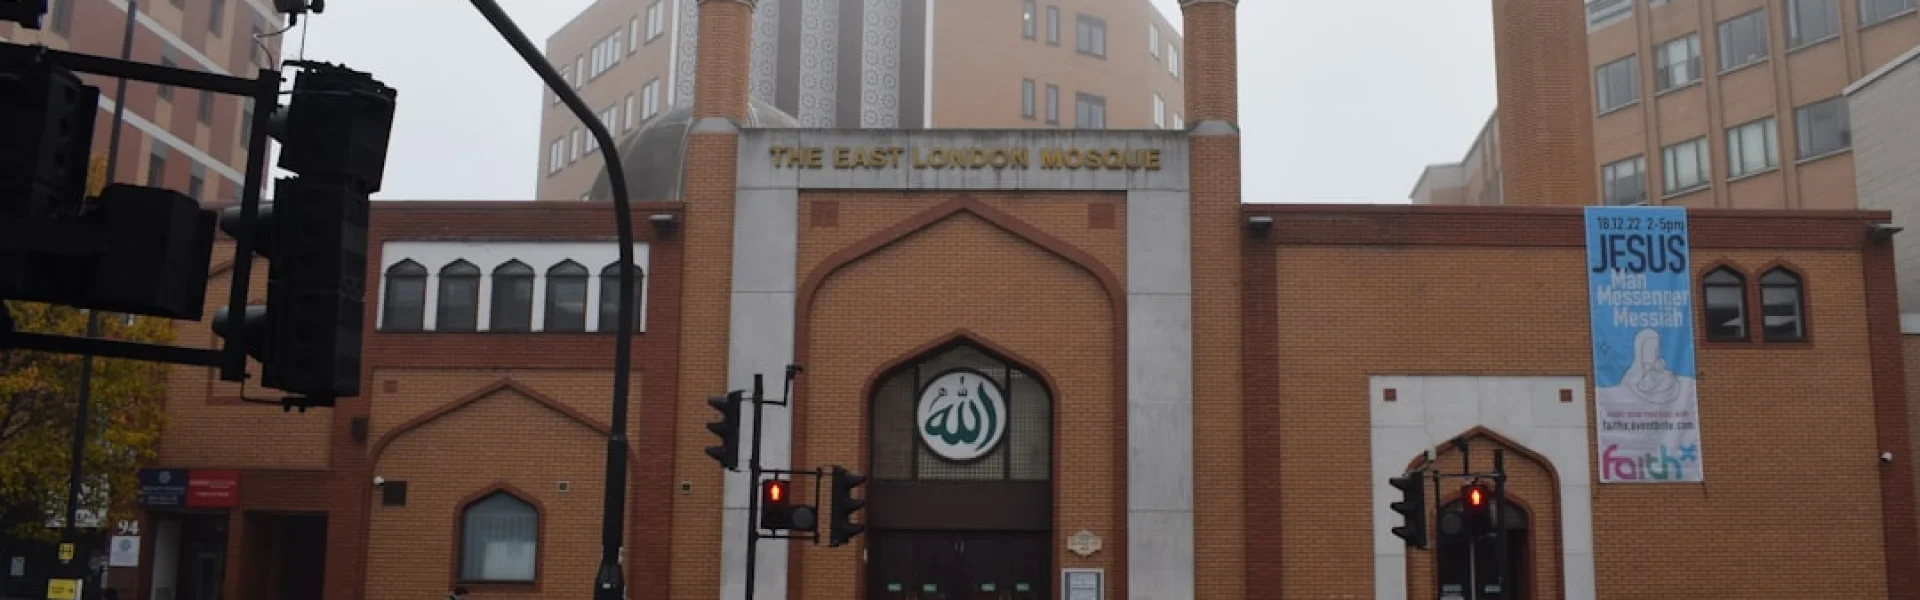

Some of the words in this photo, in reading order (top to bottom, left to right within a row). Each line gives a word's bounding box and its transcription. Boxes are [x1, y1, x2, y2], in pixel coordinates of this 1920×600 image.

[768, 146, 823, 169] THE
[834, 146, 904, 169] EAST
[913, 146, 1029, 169] LONDON
[1041, 146, 1160, 170] MOSQUE
[1597, 216, 1640, 230] 18.12.22
[1593, 234, 1686, 273] JESUS
[1611, 267, 1647, 289] Man
[1597, 284, 1689, 308] Messenger
[1613, 305, 1683, 327] Messiah
[119, 520, 139, 534] 94
